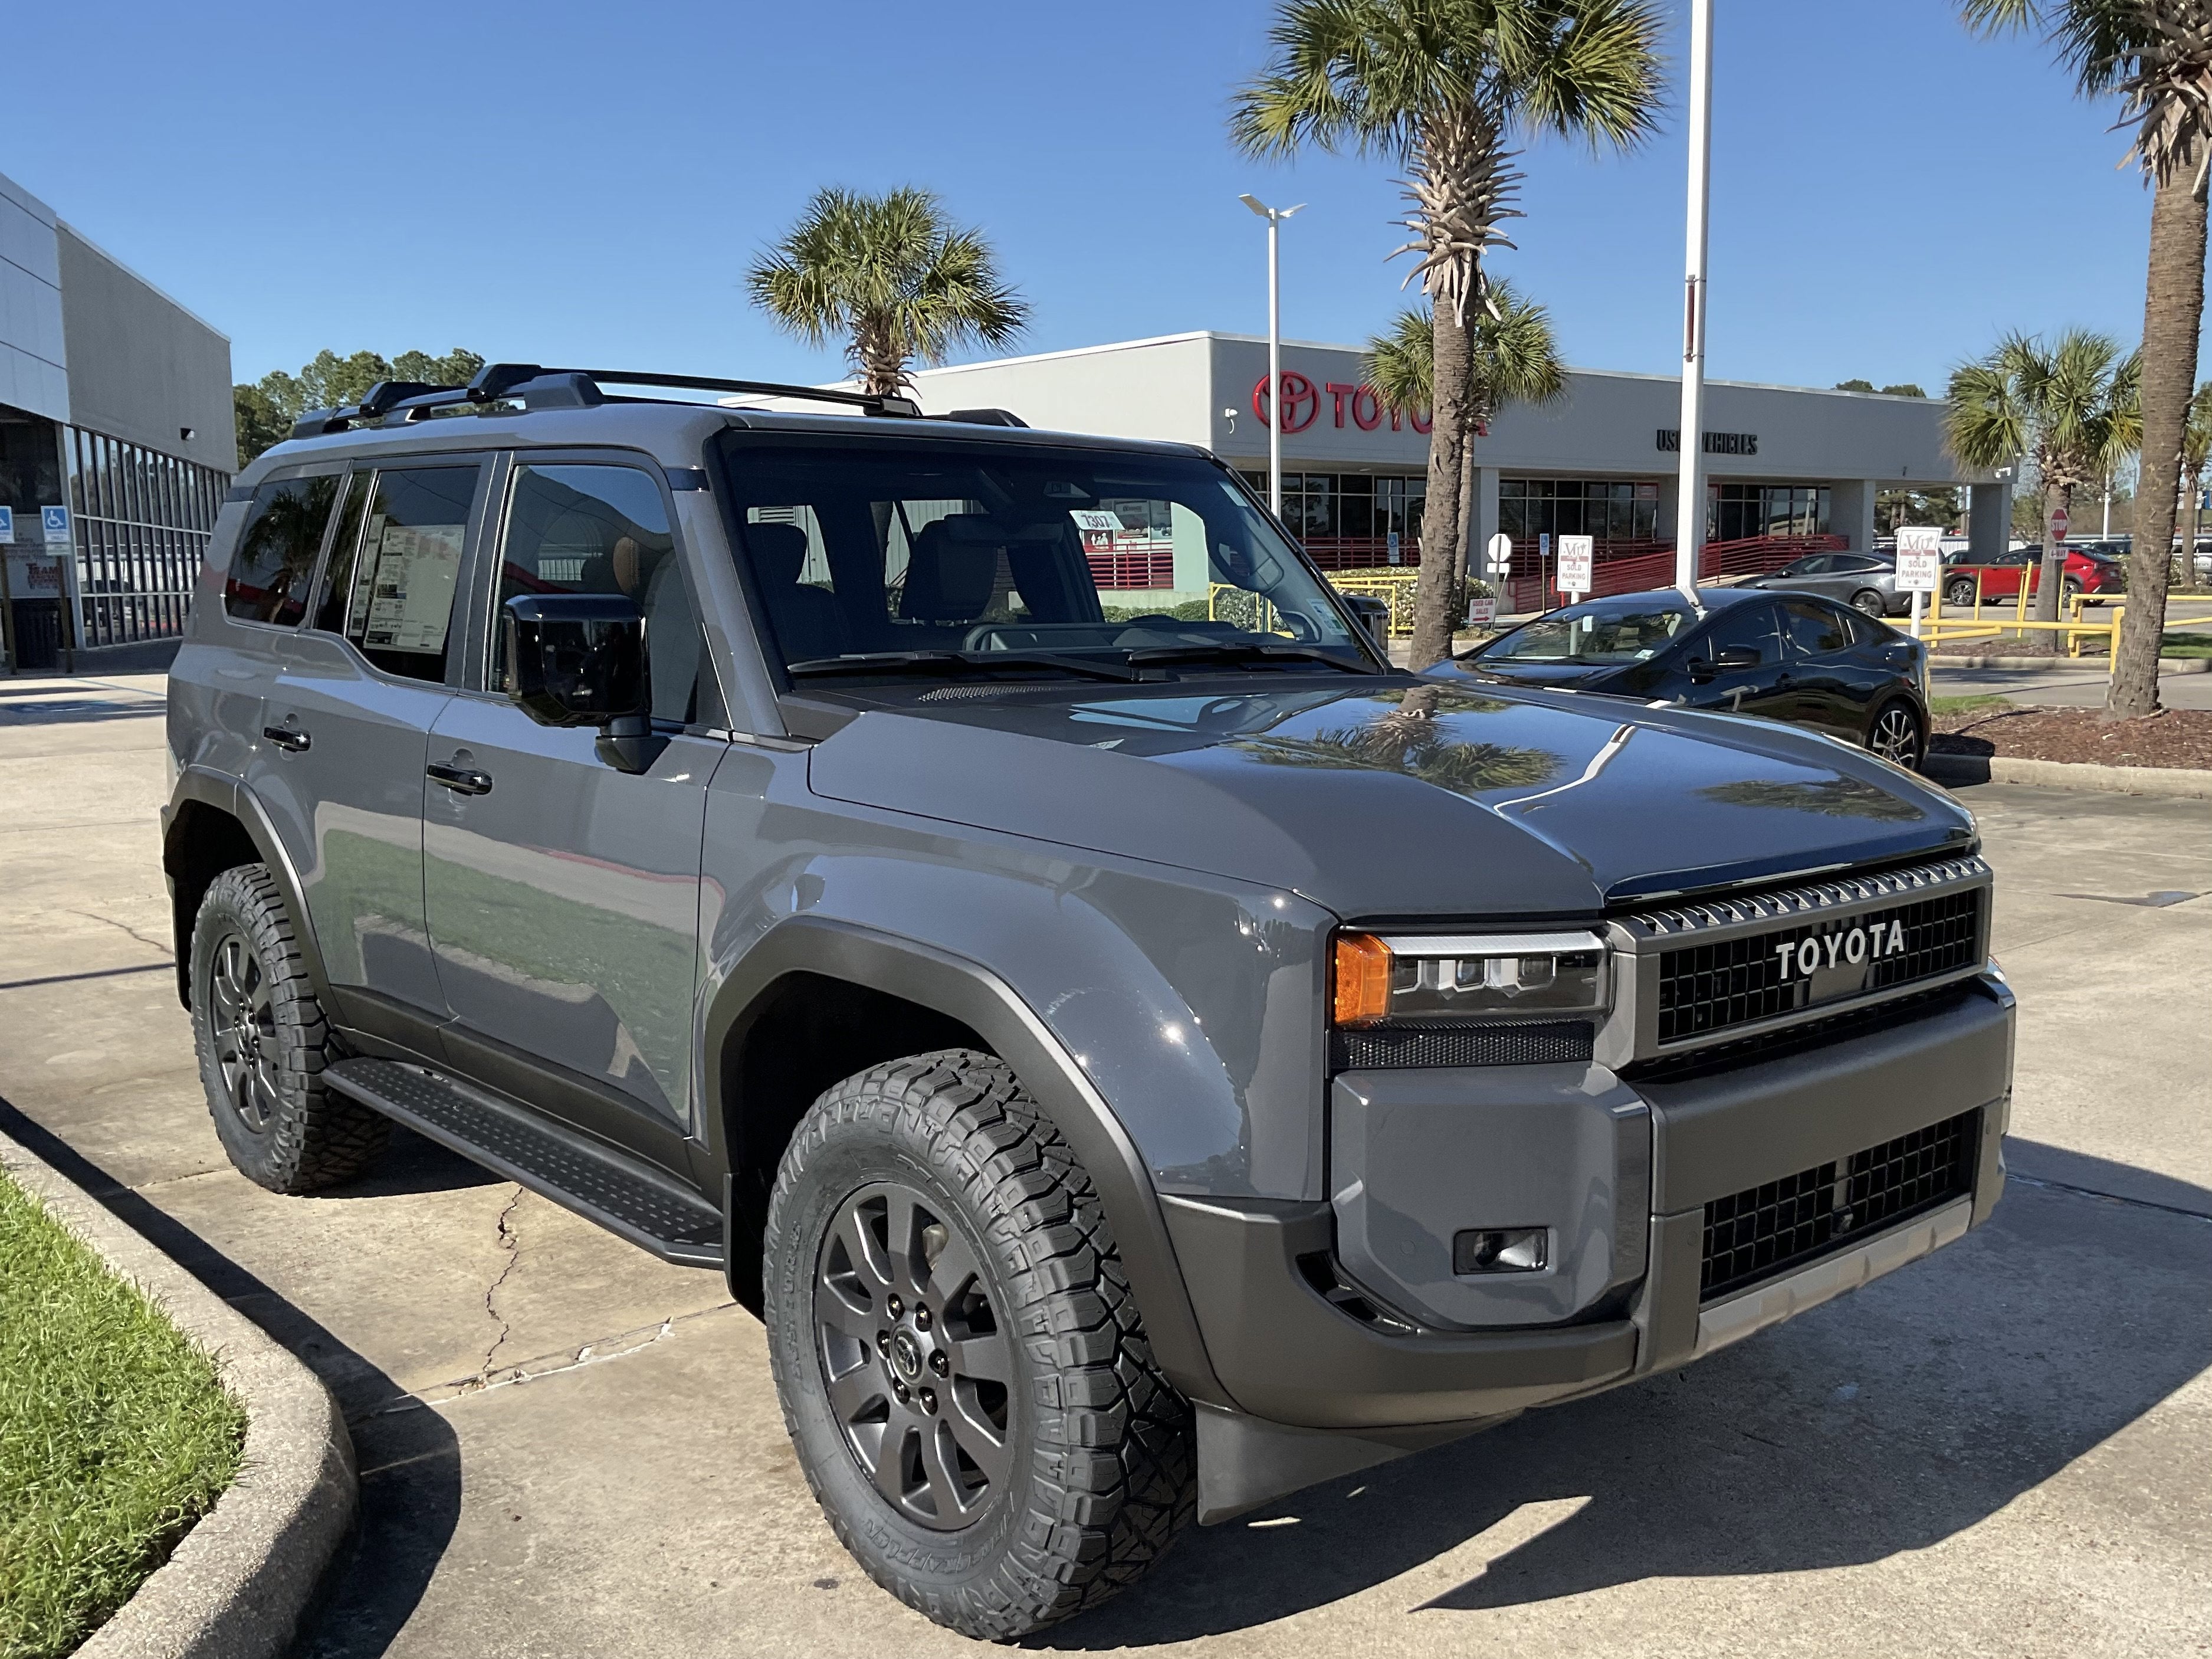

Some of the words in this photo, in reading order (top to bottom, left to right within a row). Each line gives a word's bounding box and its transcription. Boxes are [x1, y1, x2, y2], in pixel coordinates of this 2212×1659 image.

[1656, 429, 1680, 453] US
[1081, 514, 1110, 528] 7307
[2052, 519, 2067, 531] STOP
[2050, 549, 2066, 558] 4-WAY
[1901, 570, 1932, 578] PARKING
[1775, 919, 1904, 979] TOYOTA
